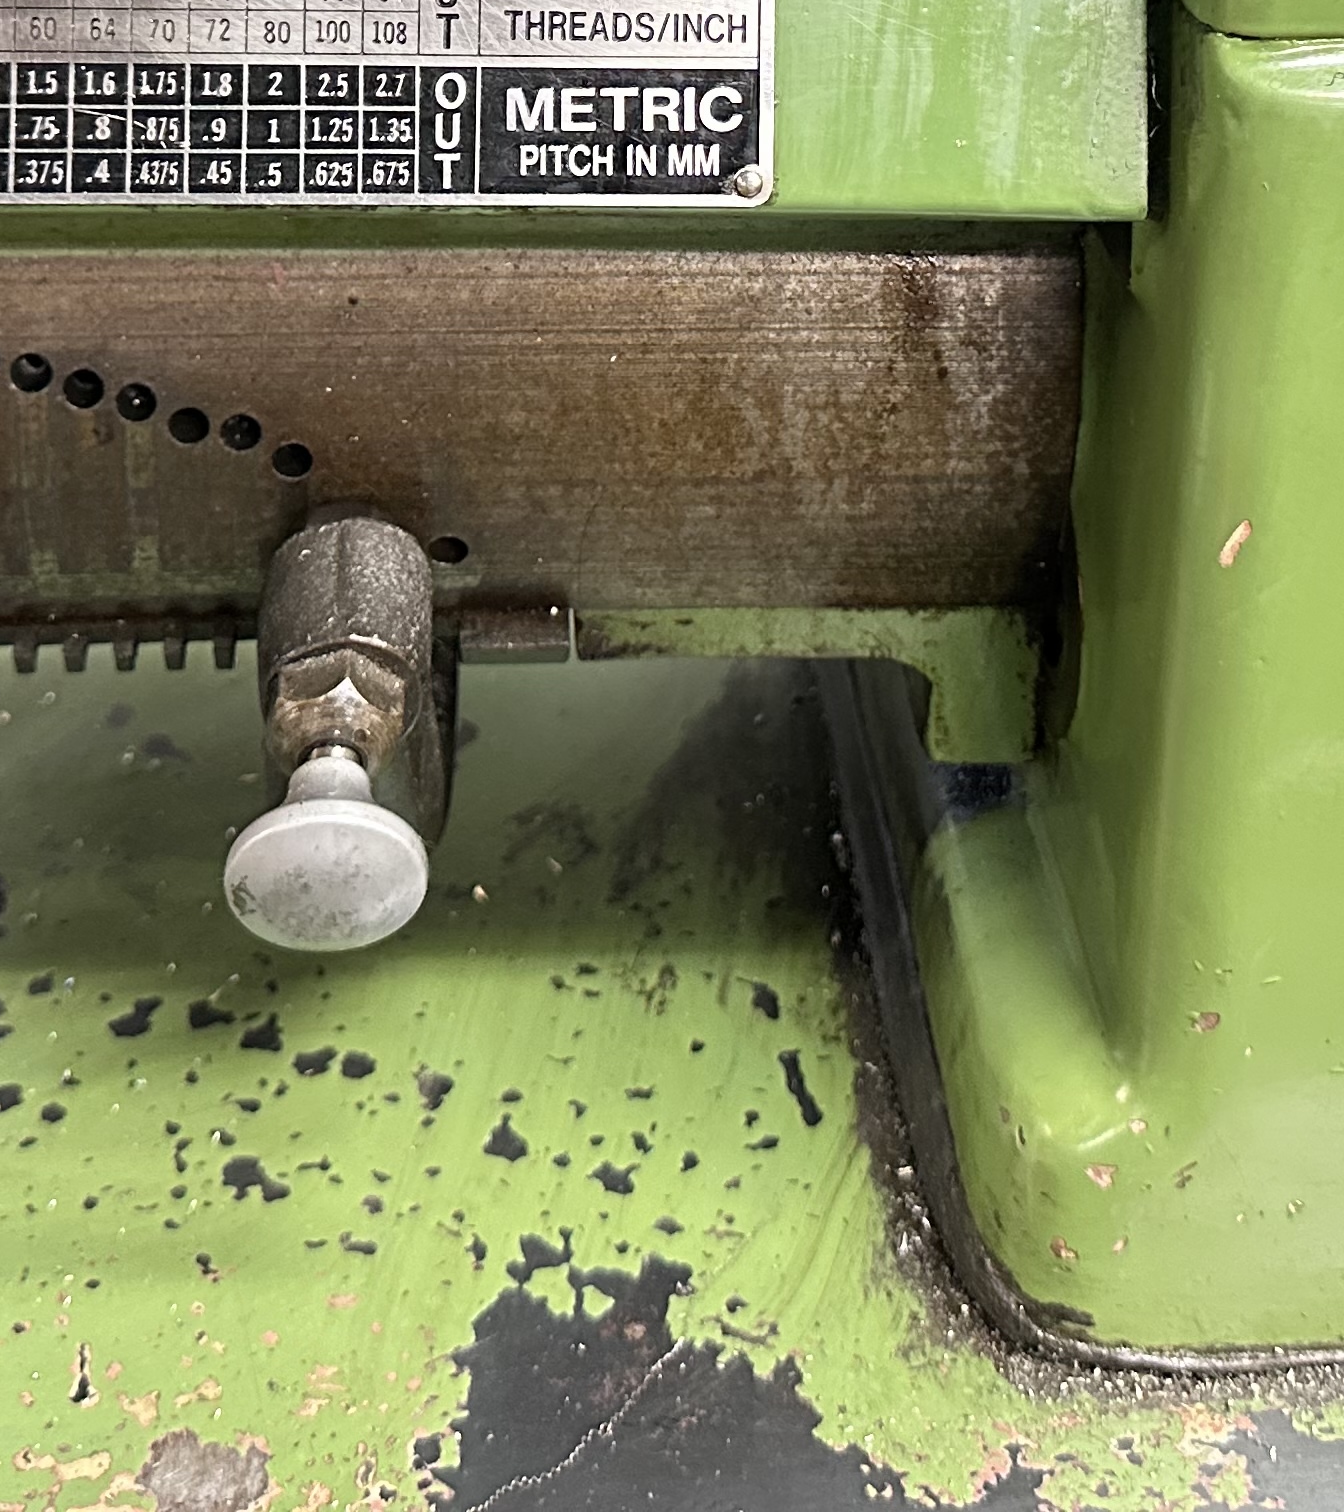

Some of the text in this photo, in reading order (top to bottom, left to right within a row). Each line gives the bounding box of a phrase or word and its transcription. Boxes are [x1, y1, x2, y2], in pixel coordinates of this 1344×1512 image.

[30, 16, 57, 40] 60
[90, 18, 116, 40] 64
[149, 19, 175, 42] 70
[206, 18, 231, 42] 72
[264, 21, 290, 43] 80
[316, 20, 350, 44] 100
[373, 21, 407, 44] 108
[504, 10, 747, 43] THREADS/INCH
[27, 70, 57, 94] 1.5
[84, 71, 116, 95] 1.6
[140, 72, 177, 95] 1.75
[202, 72, 233, 96] 1.8
[268, 72, 283, 95] 2
[317, 73, 348, 97] 2.5
[376, 74, 406, 97] 2.7
[506, 86, 744, 132] METRIC
[23, 116, 56, 140] .75
[87, 116, 110, 140] .8
[141, 117, 179, 141] .875
[202, 118, 226, 141] .9
[268, 119, 281, 142] 1
[312, 117, 353, 142] 1.25
[369, 118, 412, 142] 1.35
[434, 72, 467, 189] OUT
[18, 160, 64, 184] .375
[85, 159, 110, 183] .4
[135, 161, 178, 185] .4375
[200, 160, 232, 184] .45
[258, 163, 282, 187] .5
[309, 161, 353, 187] .625
[366, 161, 409, 186] .675
[520, 144, 720, 176] PITCH IN MM
